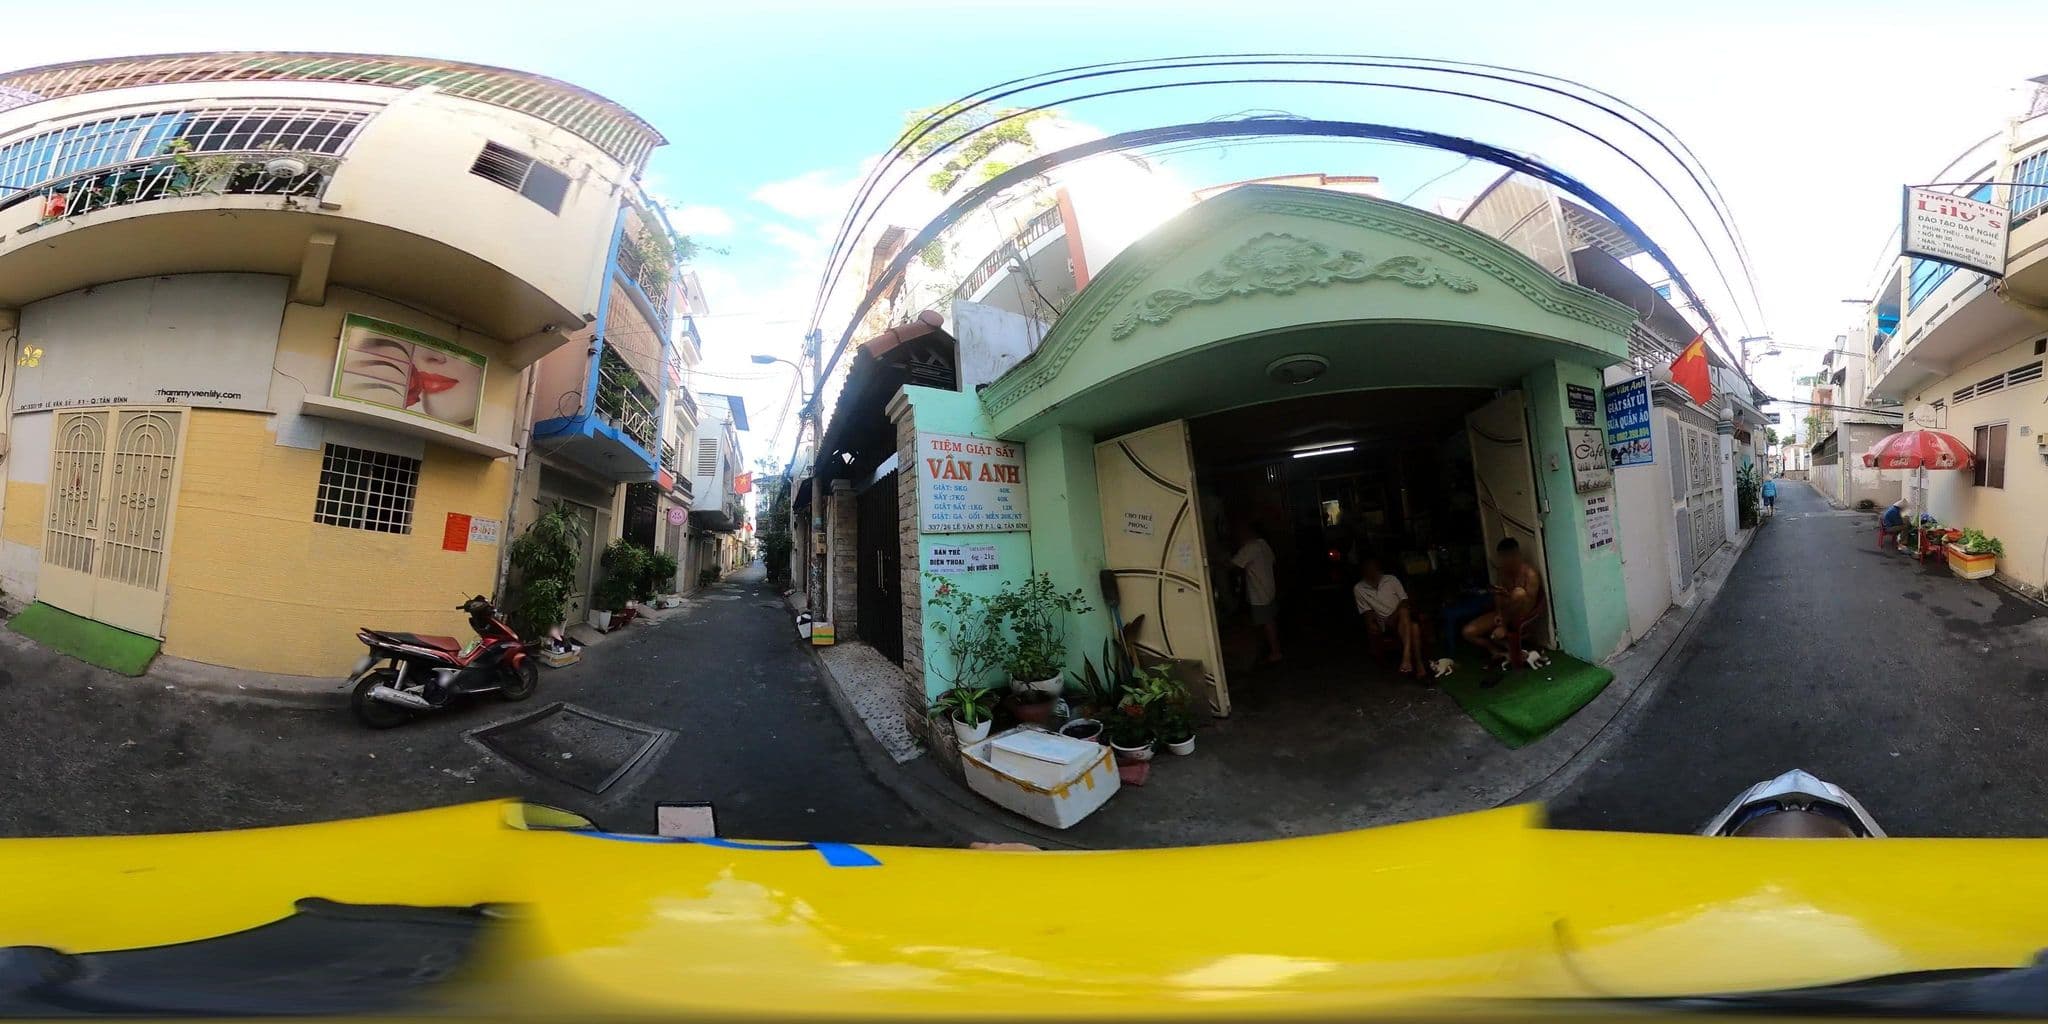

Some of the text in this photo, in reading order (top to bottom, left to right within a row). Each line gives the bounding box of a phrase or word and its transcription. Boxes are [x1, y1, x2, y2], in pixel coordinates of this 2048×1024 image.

[931, 439, 1015, 458] TIỆM GIẶT SẤY
[927, 455, 1021, 484] VÂN ANH
